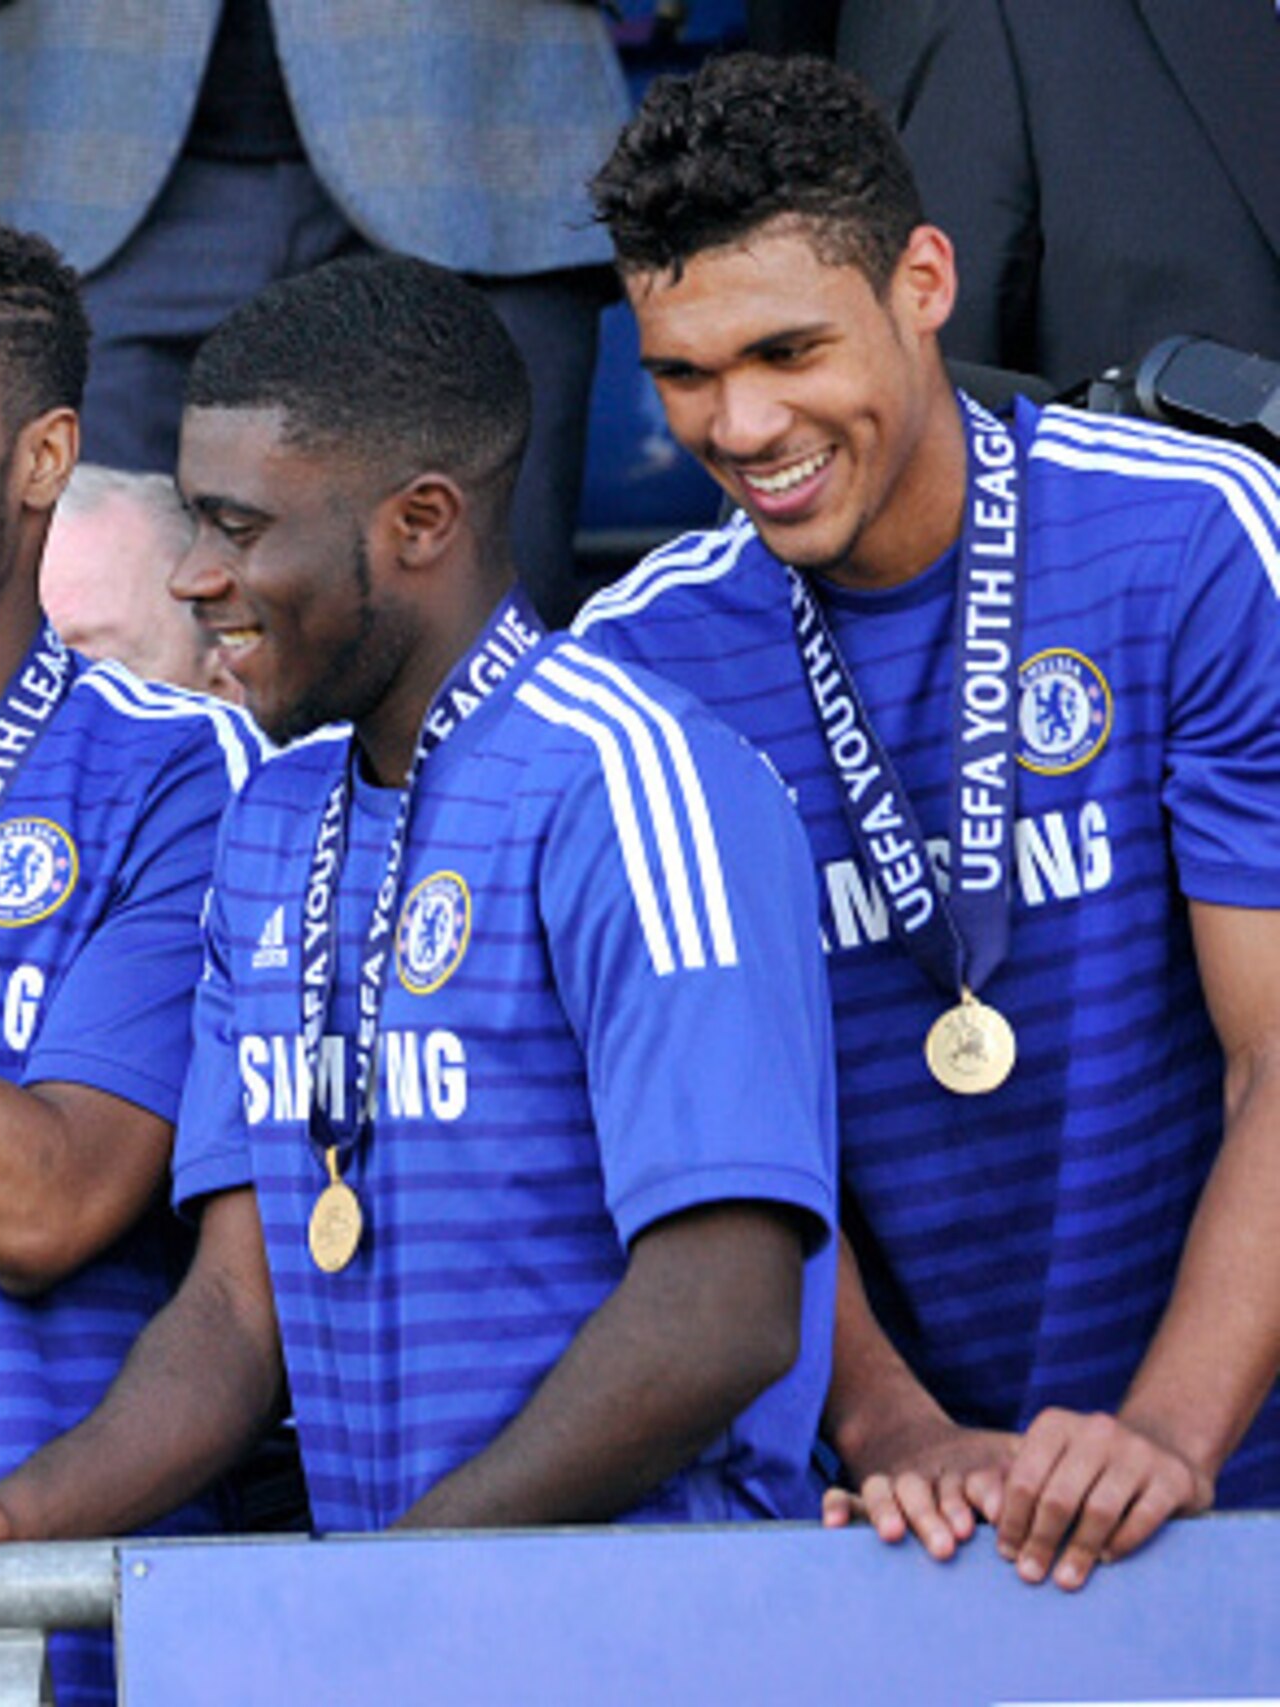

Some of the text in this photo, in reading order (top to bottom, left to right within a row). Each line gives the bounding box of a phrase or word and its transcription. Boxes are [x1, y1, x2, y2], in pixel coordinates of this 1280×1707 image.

[962, 570, 1015, 737] YOUTH
[803, 632, 934, 932] UEFA YOUTH
[961, 752, 1007, 890] UEFA
[304, 783, 346, 951] YOUTH
